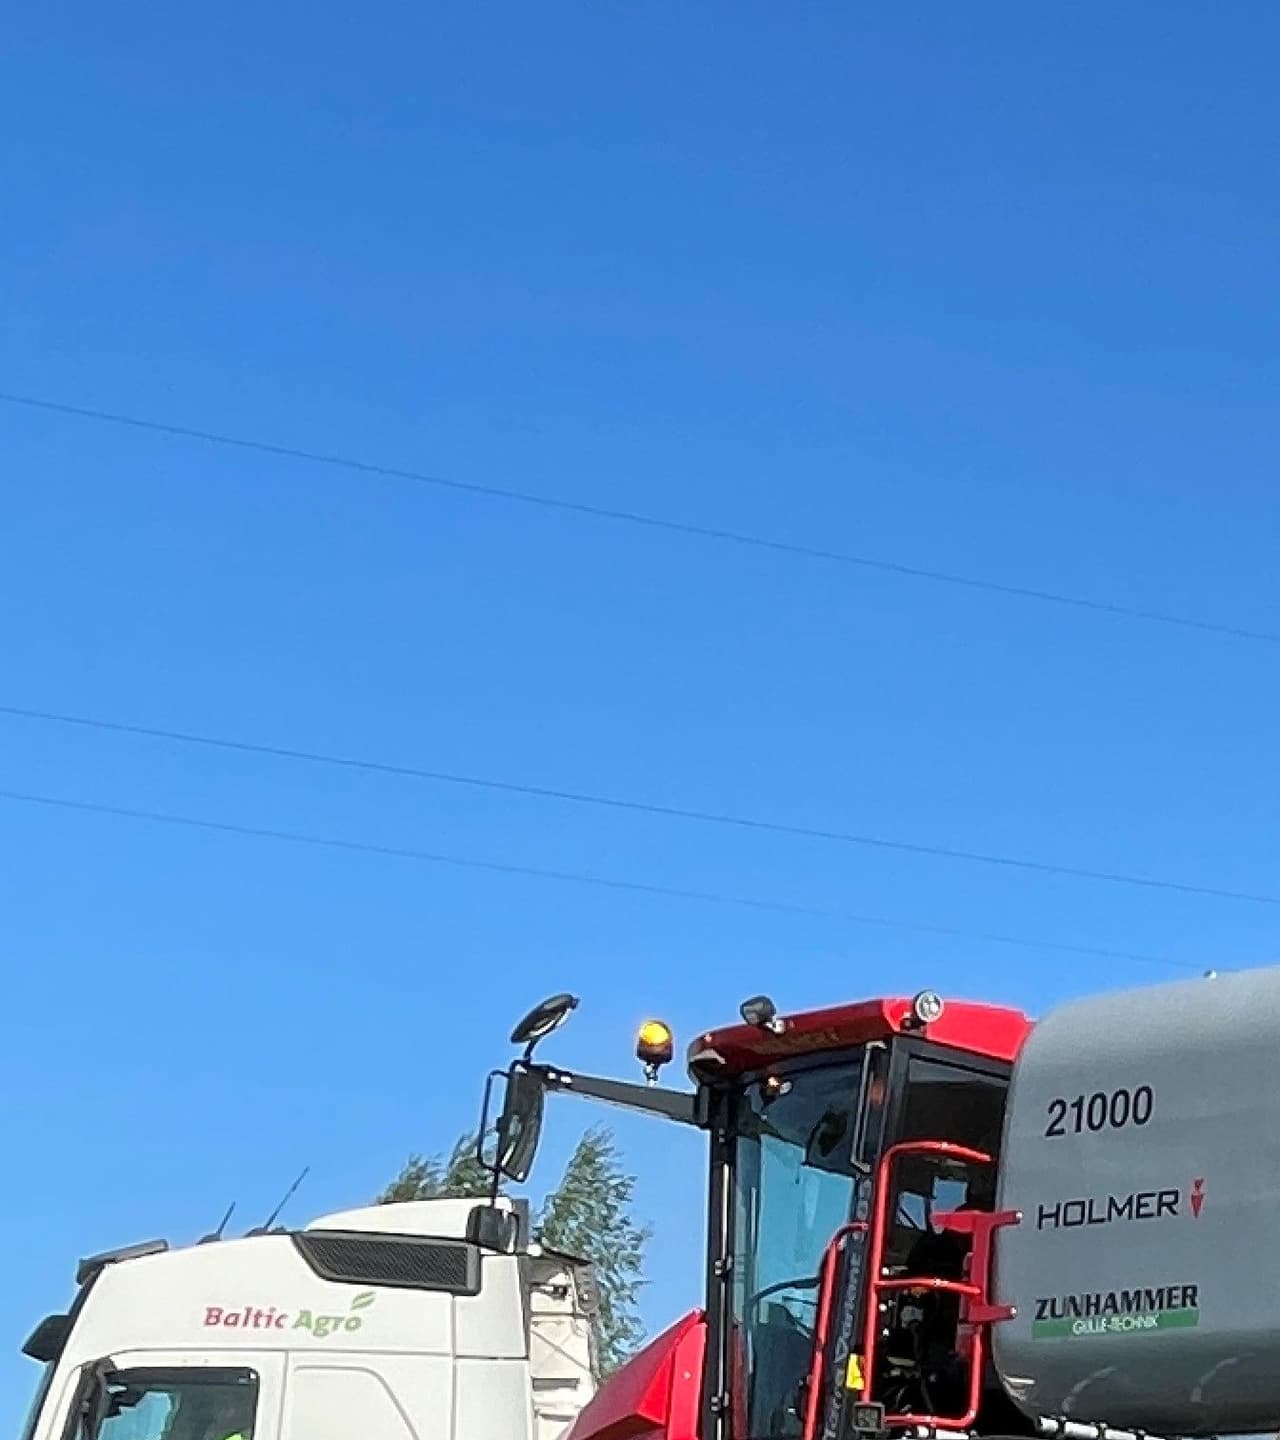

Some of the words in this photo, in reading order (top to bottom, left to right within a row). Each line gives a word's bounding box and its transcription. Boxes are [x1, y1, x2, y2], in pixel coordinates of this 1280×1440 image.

[1045, 1085, 1153, 1137] 21000
[1037, 1189, 1180, 1231] HOLMER
[203, 1306, 289, 1329] Baltic
[291, 1309, 362, 1337] Agro
[1034, 1284, 1199, 1321] ZUNHAMMER
